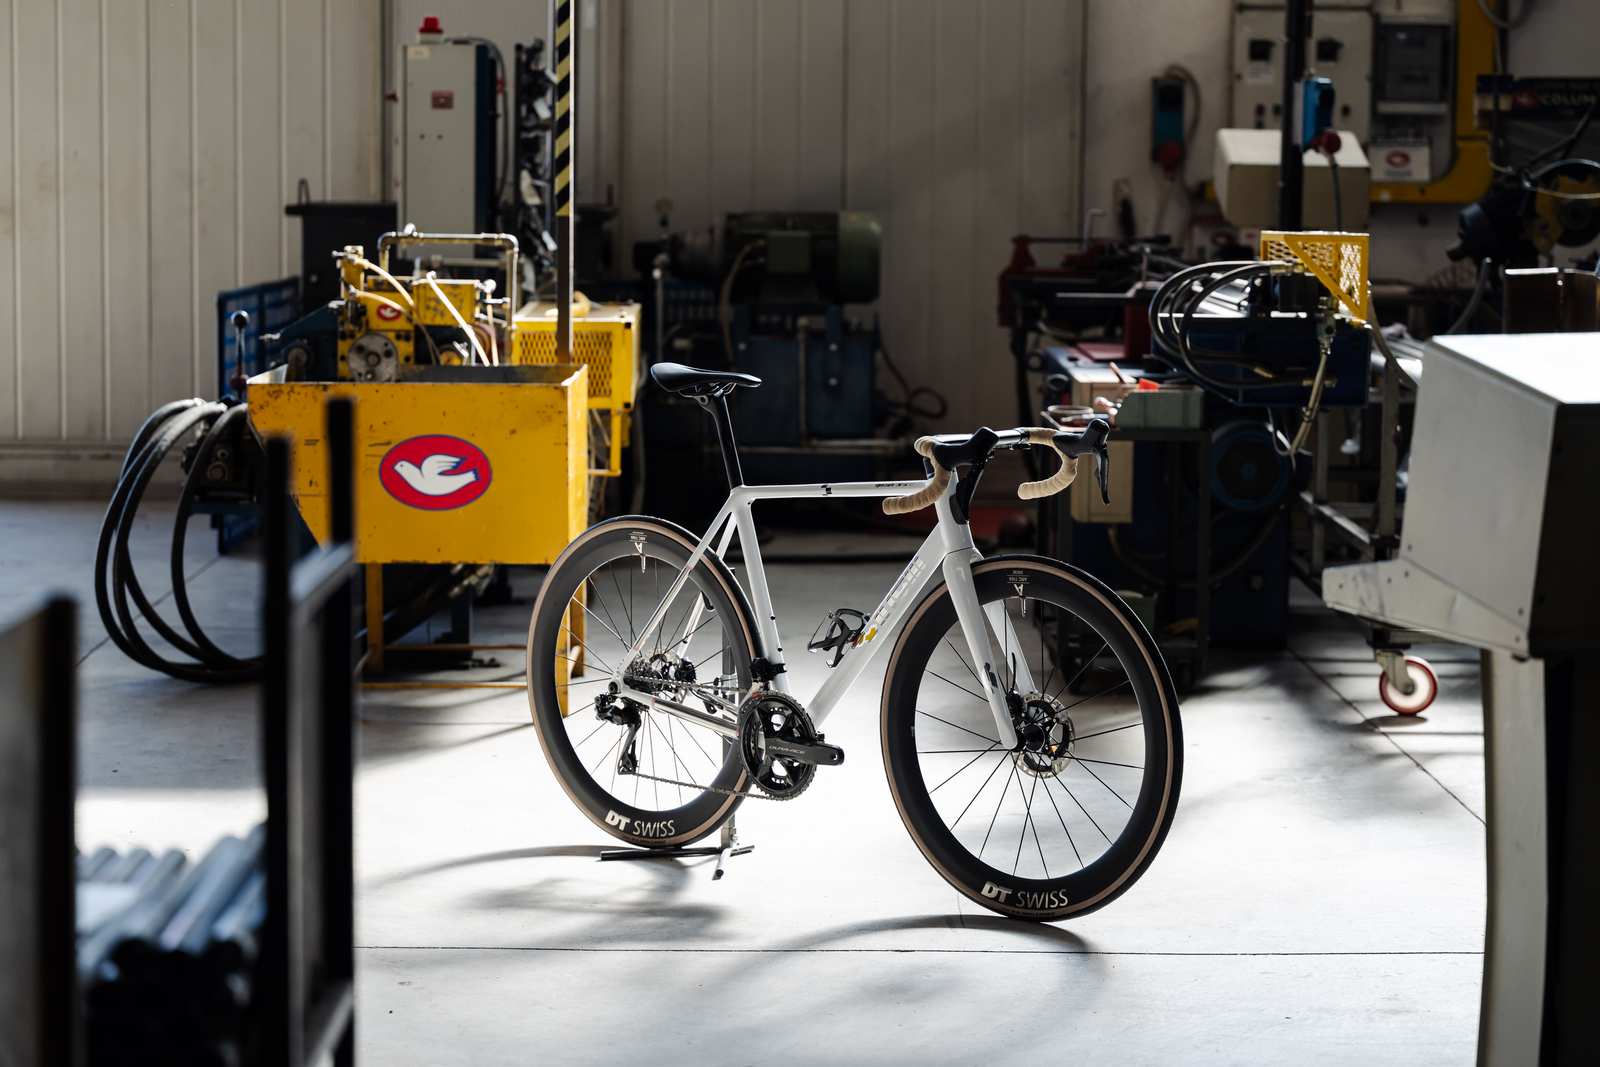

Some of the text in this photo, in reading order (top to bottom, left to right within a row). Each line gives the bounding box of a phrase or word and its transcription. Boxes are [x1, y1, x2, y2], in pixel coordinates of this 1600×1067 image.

[605, 810, 676, 838] DT SWISS
[981, 881, 1068, 909] DT SWISS
